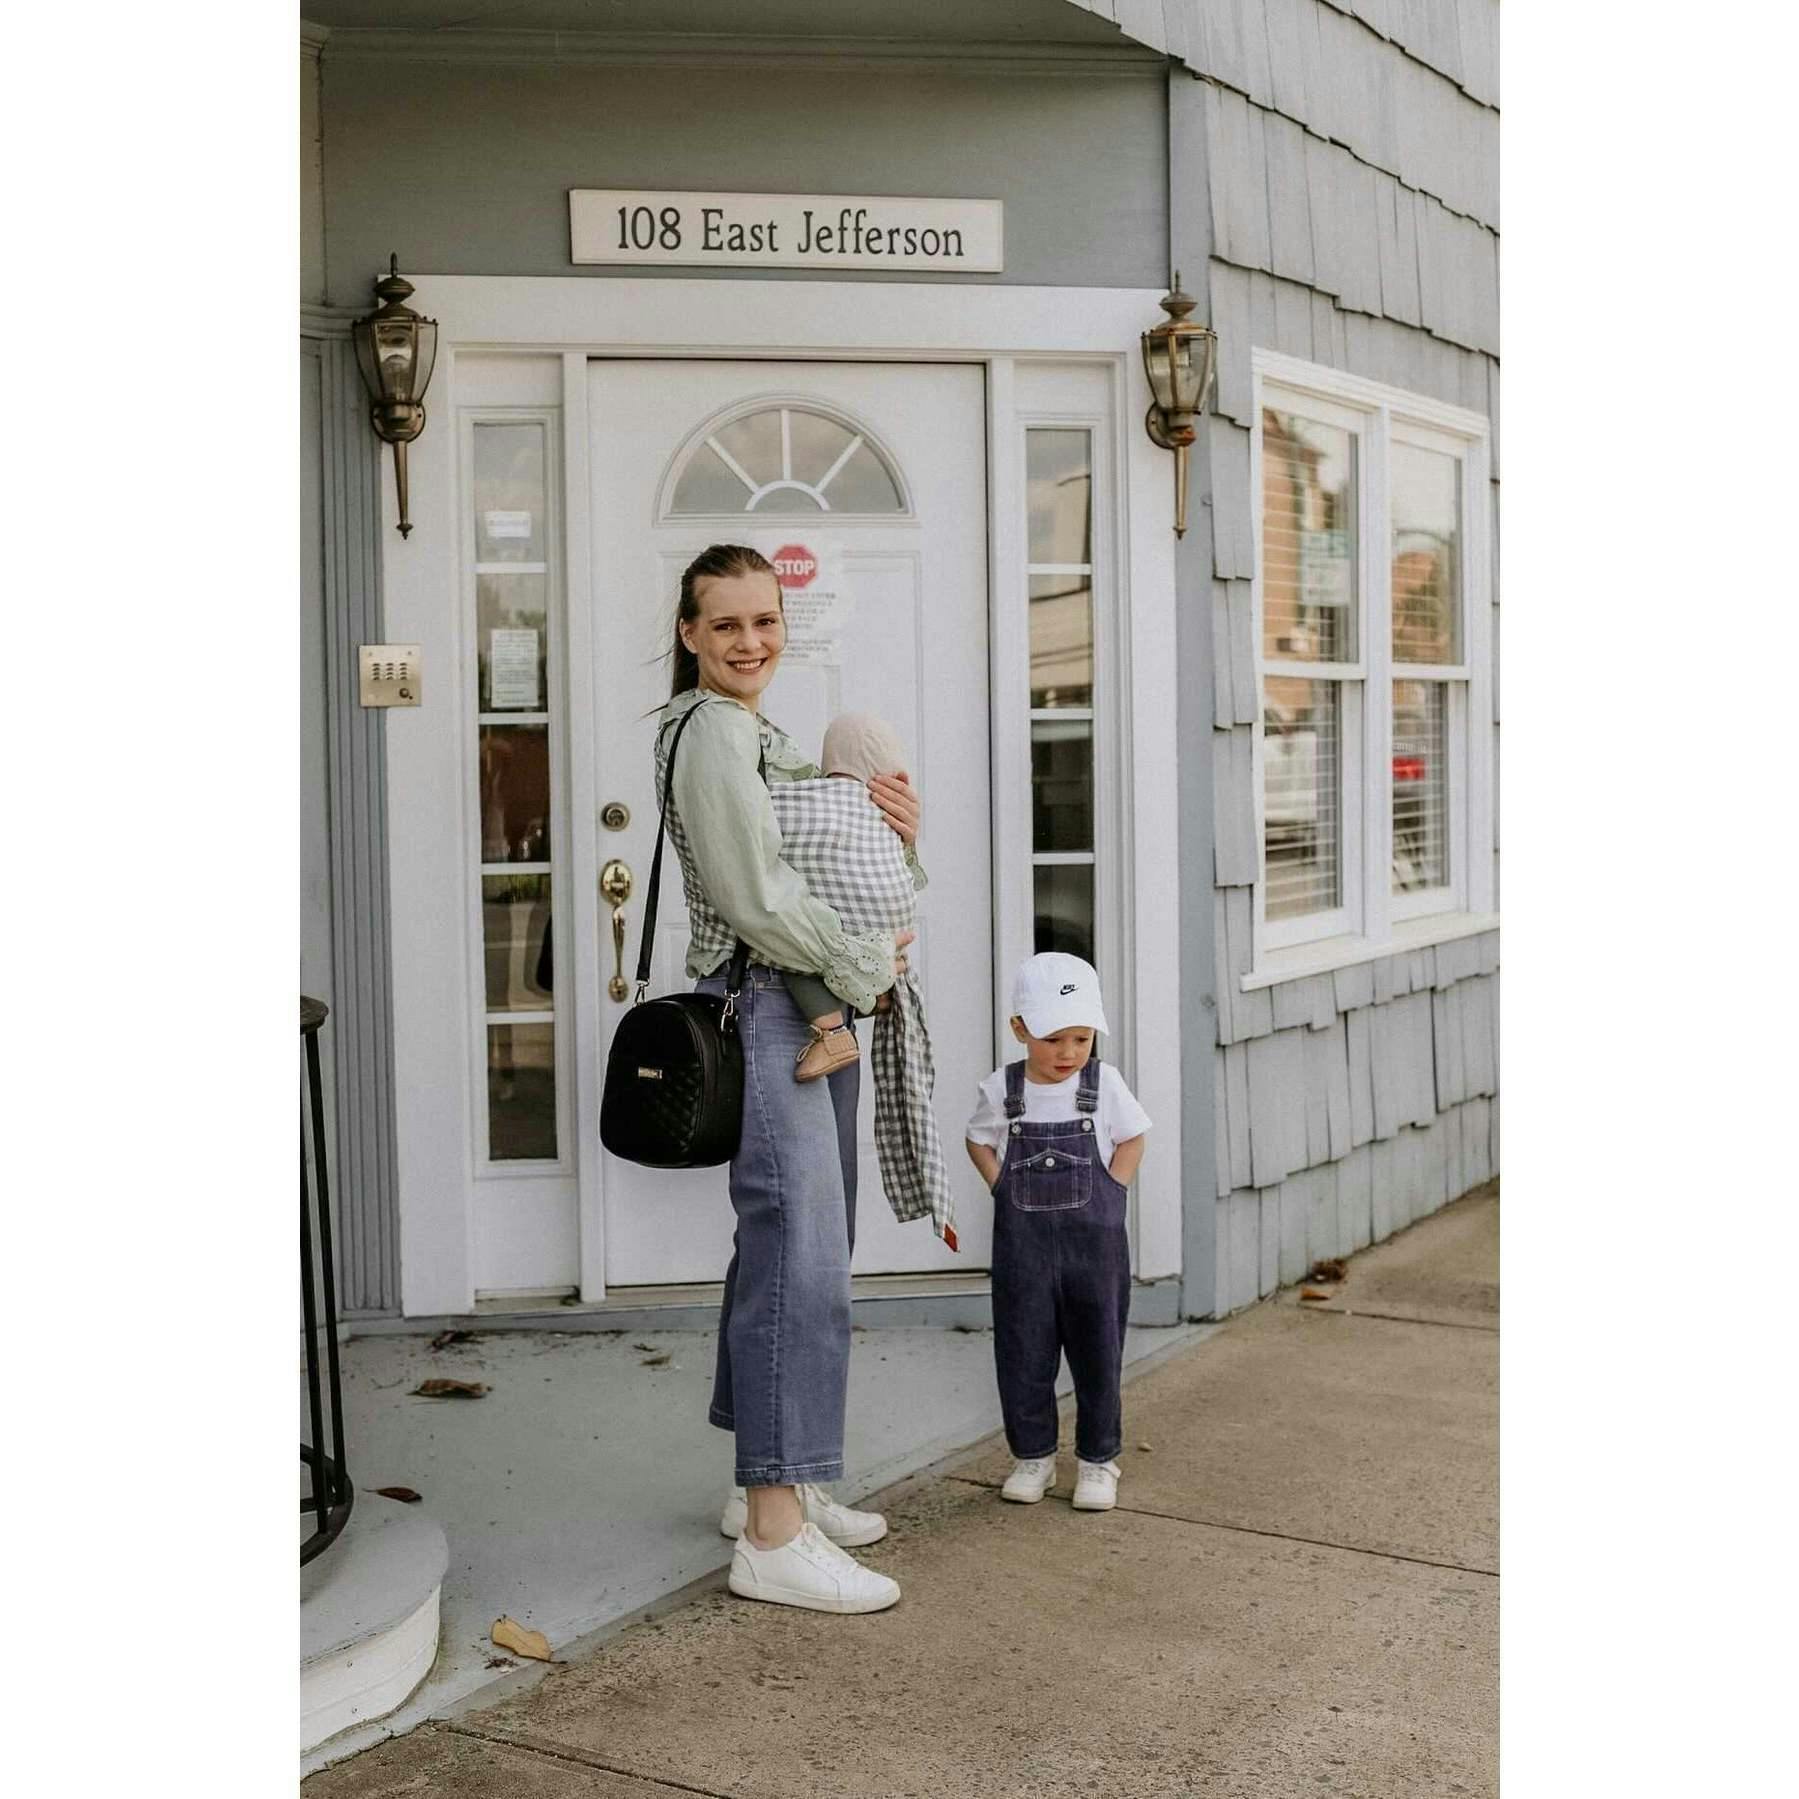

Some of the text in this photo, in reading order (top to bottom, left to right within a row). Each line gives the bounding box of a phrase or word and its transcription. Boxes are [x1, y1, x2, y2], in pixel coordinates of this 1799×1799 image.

[617, 206, 965, 256] 108 East Jefferson
[774, 560, 815, 576] STOP
